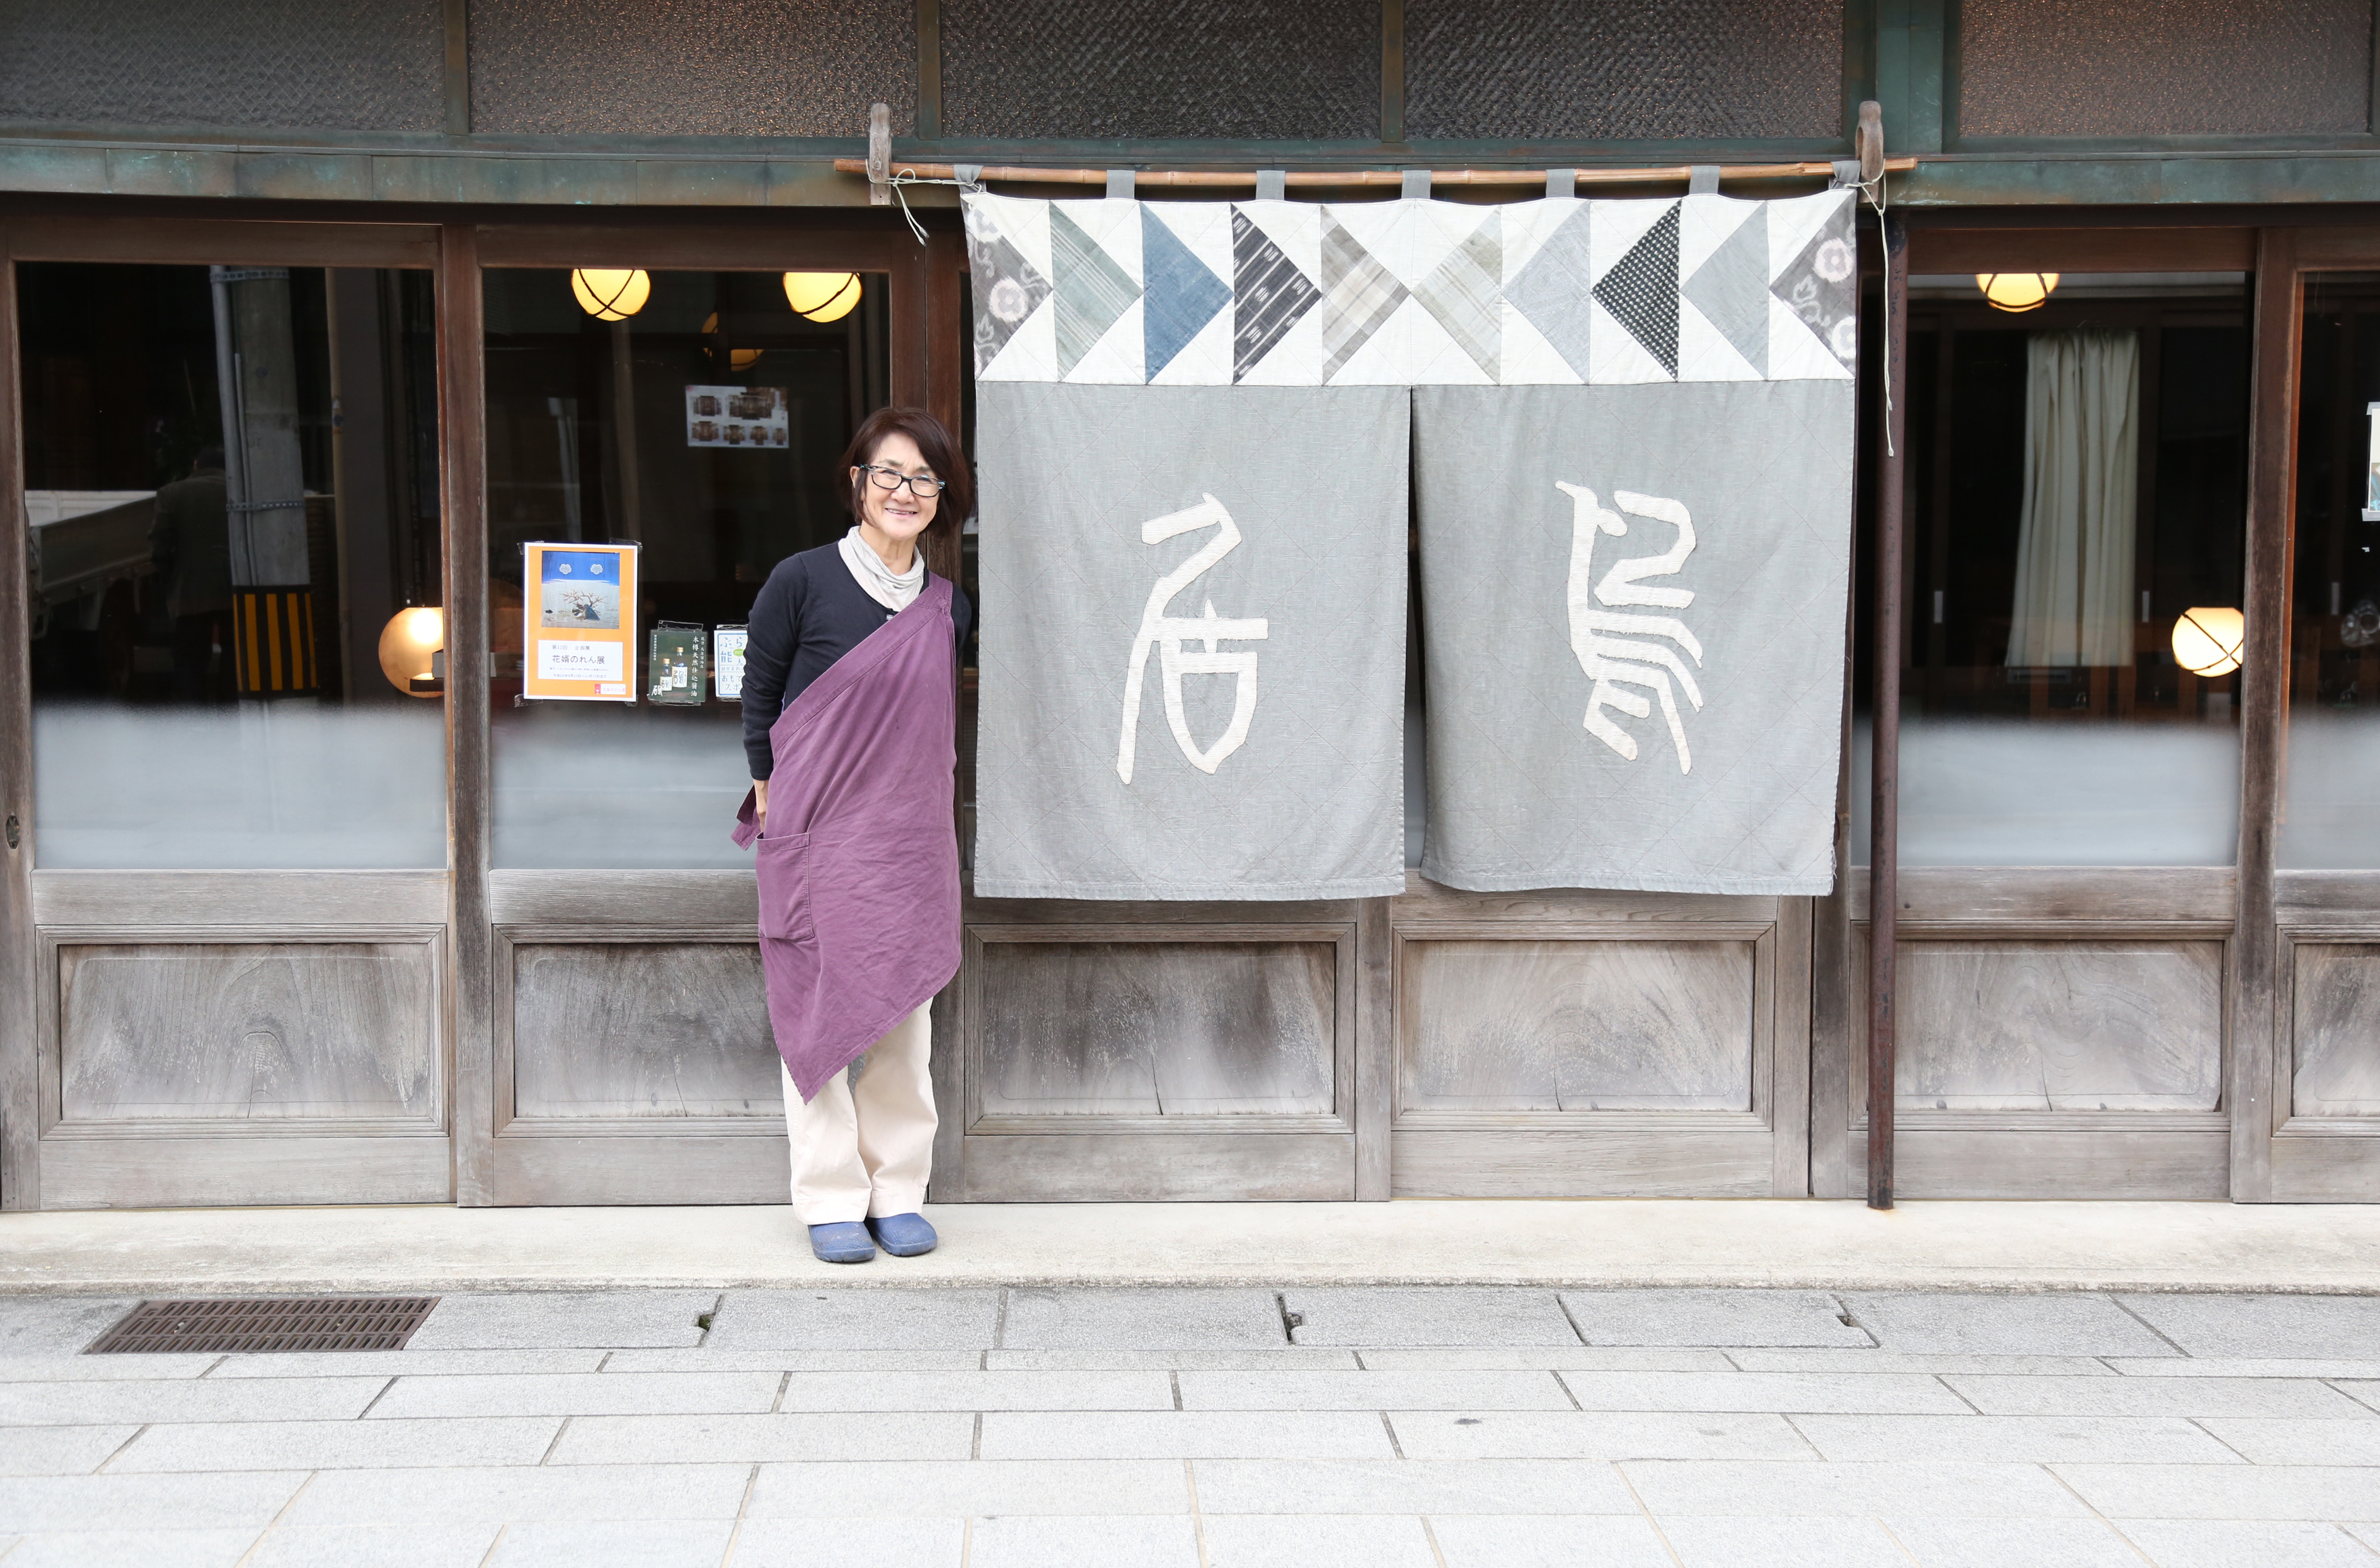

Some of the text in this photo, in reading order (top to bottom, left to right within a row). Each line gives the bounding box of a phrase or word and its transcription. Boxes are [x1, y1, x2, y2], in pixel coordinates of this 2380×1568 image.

[552, 655, 606, 664] 花婿のれん展
